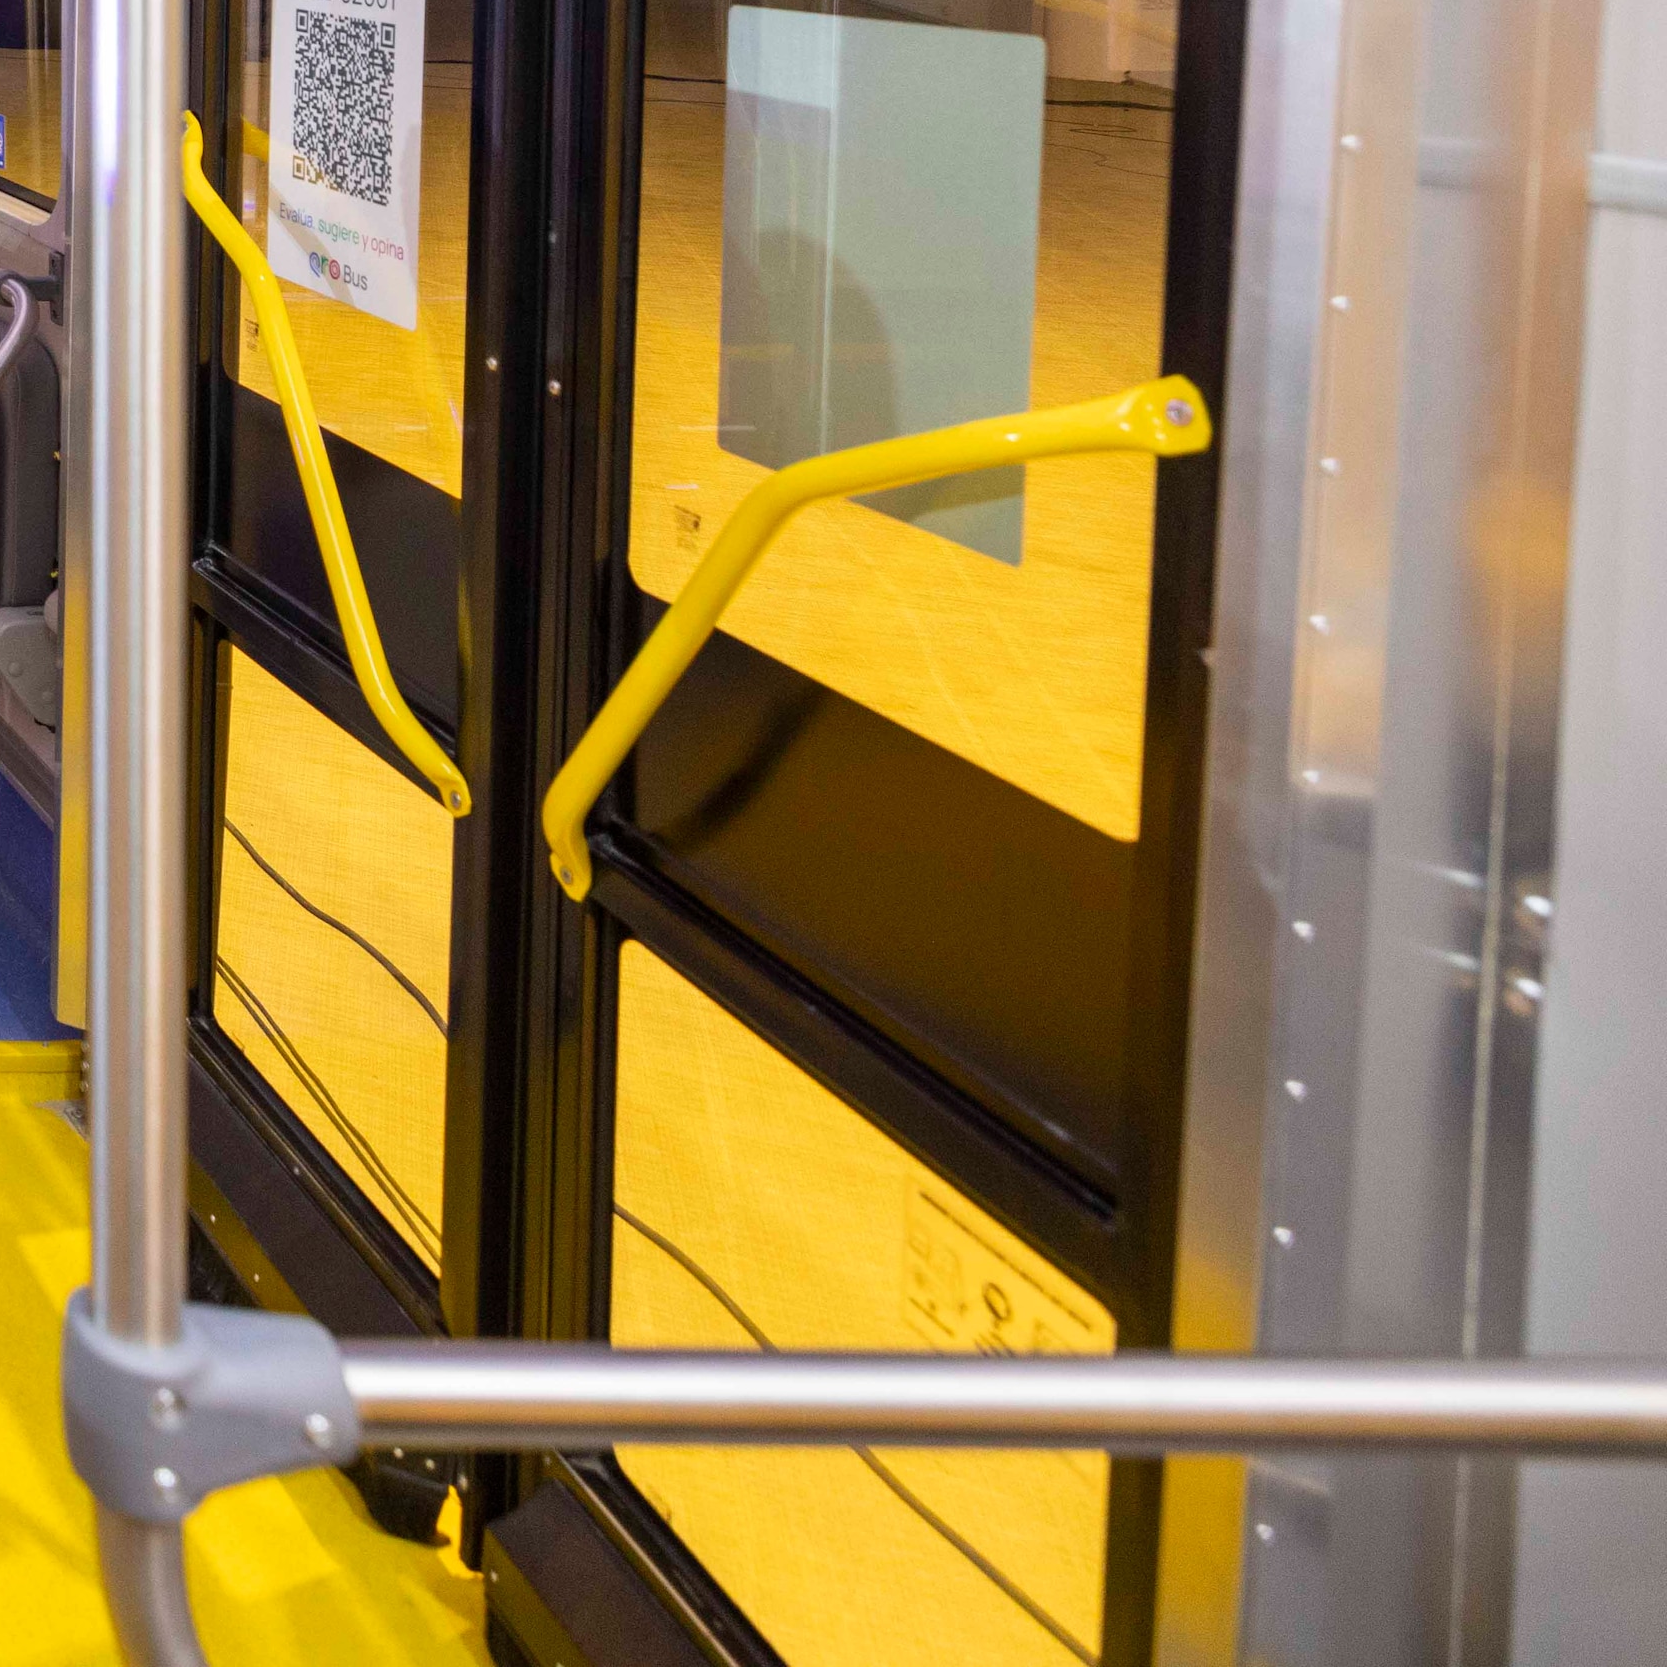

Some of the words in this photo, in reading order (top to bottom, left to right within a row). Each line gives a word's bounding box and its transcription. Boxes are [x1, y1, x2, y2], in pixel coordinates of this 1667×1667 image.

[317, 217, 361, 246] sugiere
[360, 231, 369, 250] y
[370, 235, 405, 261] opina
[342, 263, 369, 291] Bus
